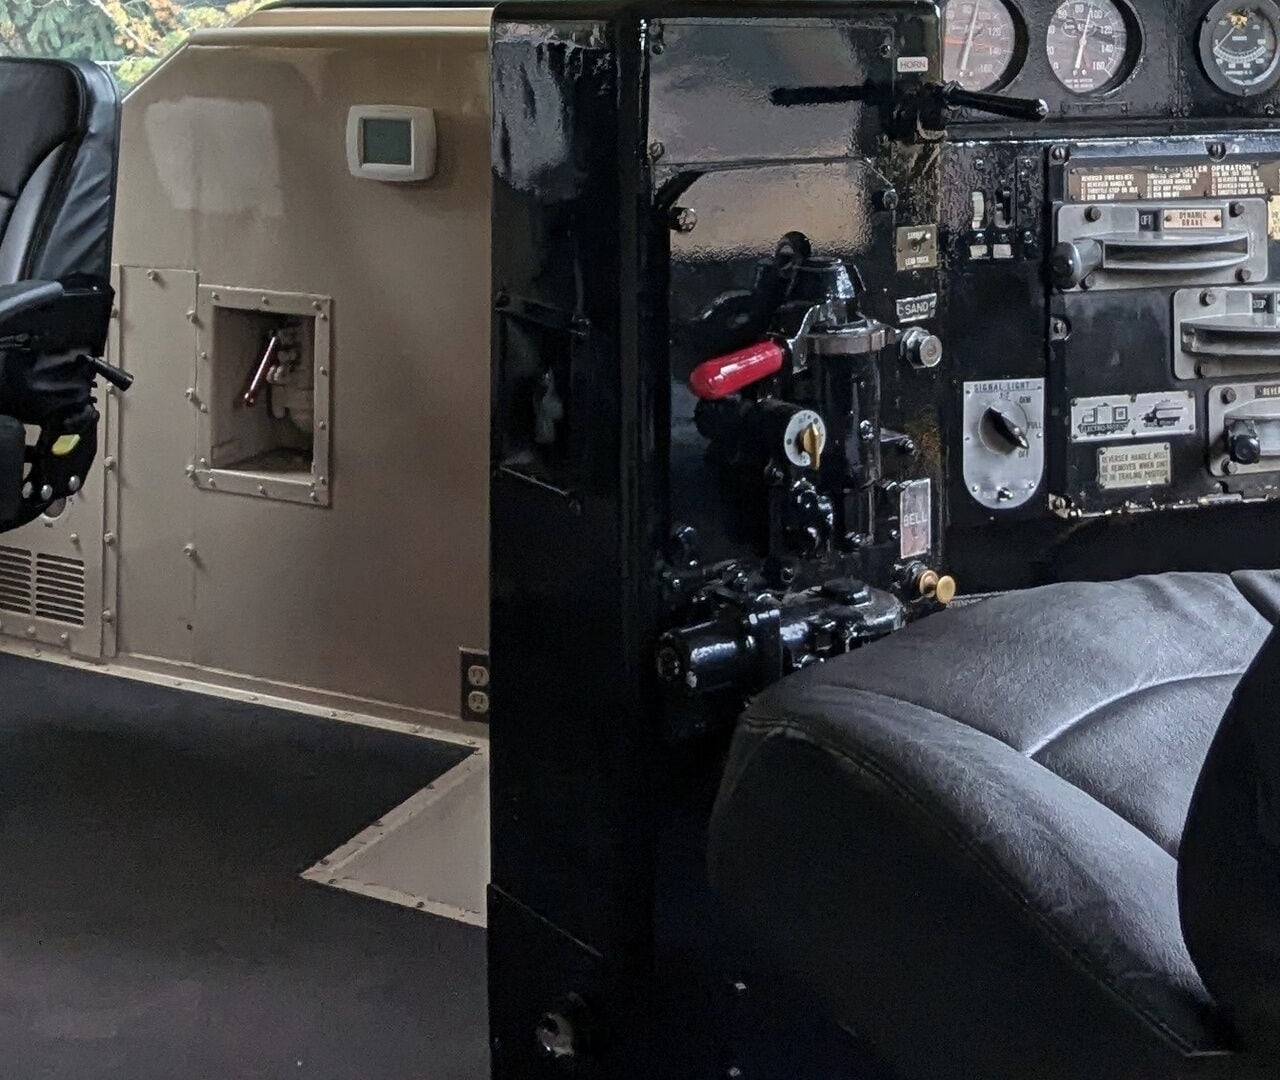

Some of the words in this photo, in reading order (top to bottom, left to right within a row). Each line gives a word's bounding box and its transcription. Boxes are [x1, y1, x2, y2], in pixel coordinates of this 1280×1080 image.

[900, 60, 926, 69] HORN
[1179, 211, 1207, 219] DYNAMIC
[905, 302, 928, 315] SAND
[974, 383, 1002, 392] SIGNAL
[1007, 381, 1030, 390] LIGHT
[904, 511, 928, 526] BELL
